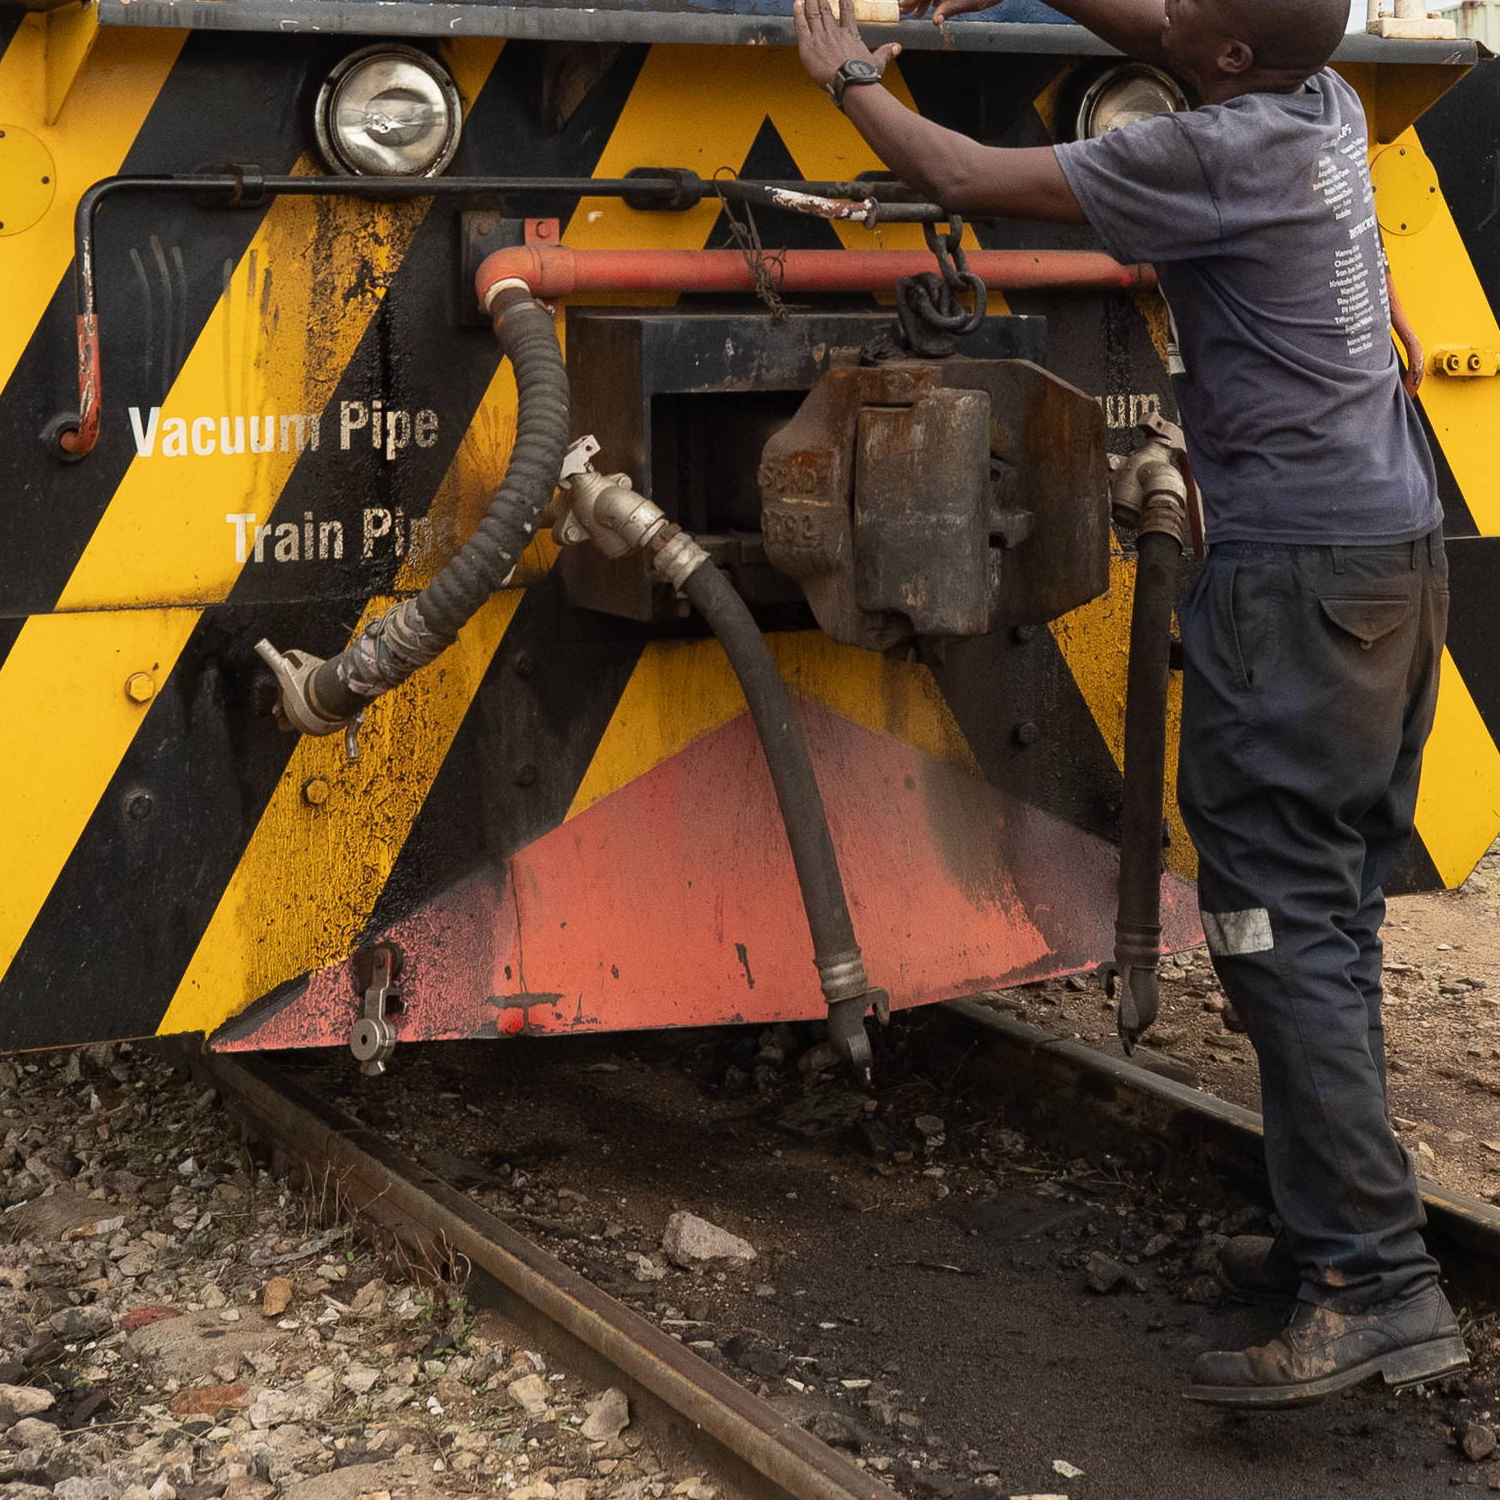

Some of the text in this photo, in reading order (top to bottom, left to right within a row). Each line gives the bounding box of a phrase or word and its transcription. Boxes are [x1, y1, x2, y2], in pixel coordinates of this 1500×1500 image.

[128, 400, 440, 461] Vacuum Pipe
[226, 510, 344, 564] Train
